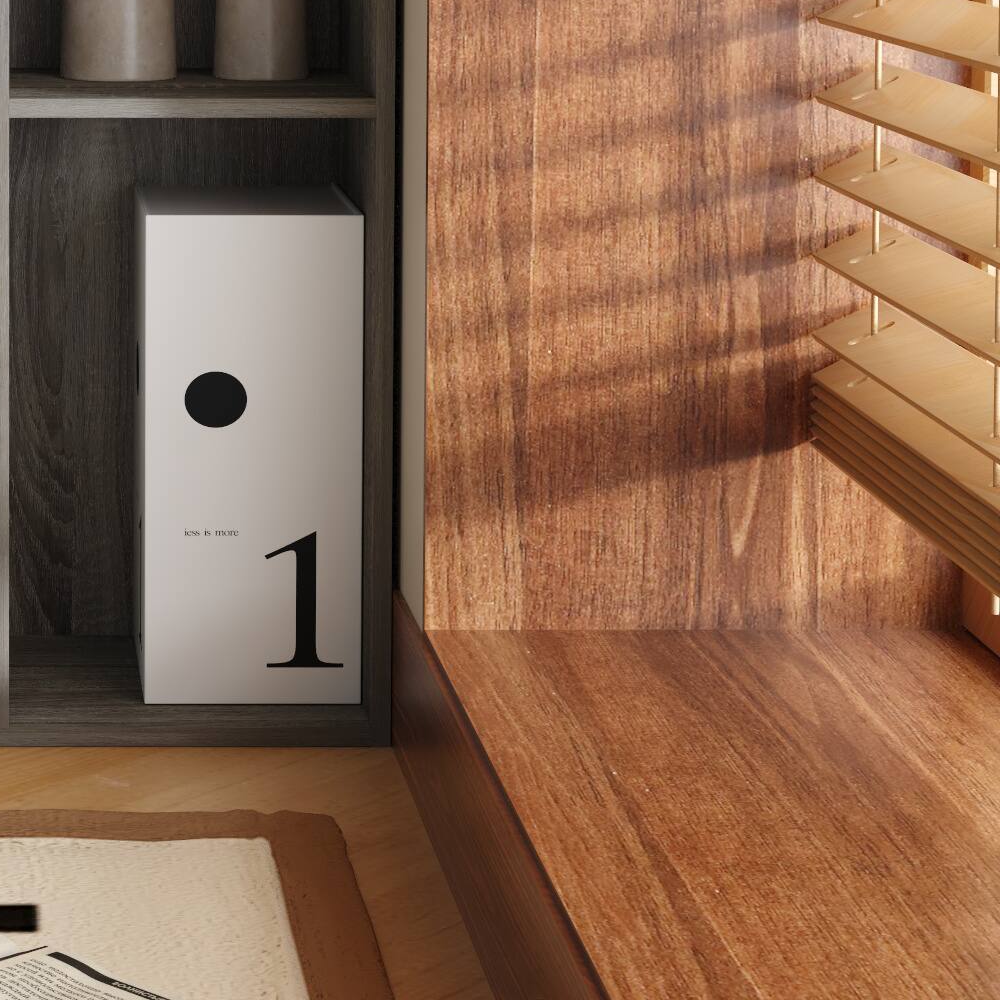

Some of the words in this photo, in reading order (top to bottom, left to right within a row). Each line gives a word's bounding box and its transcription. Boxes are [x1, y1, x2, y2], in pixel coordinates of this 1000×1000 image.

[204, 528, 211, 536] is
[215, 529, 240, 537] more
[265, 531, 343, 667] 1
